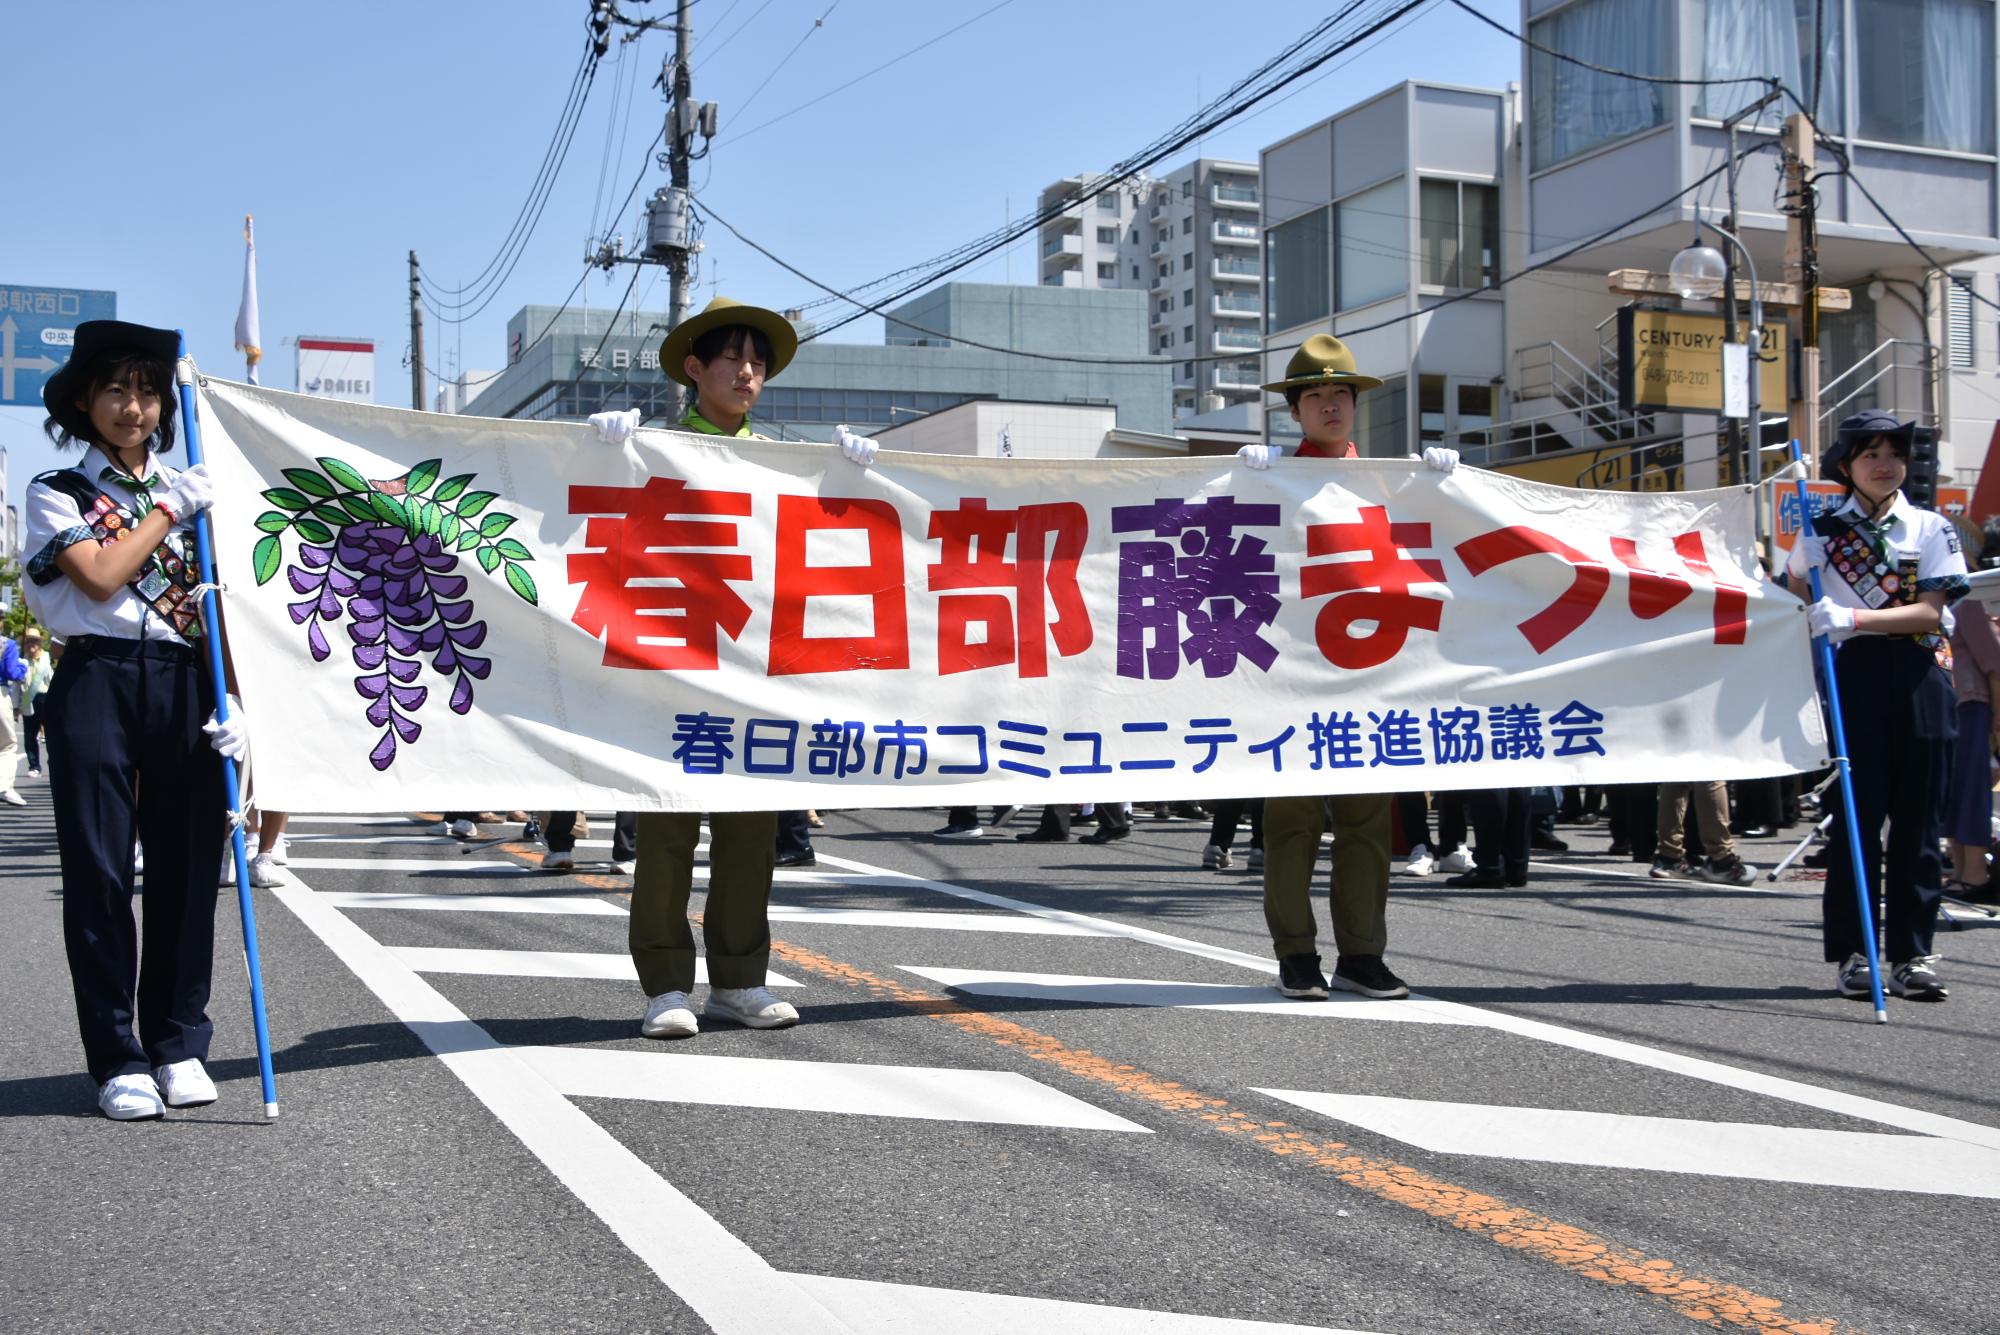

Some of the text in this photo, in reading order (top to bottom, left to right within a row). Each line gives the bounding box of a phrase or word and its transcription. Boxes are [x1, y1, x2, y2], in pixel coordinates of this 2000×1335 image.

[45, 331, 75, 343] 中央
[1639, 329, 1715, 349] CENTURY
[324, 378, 371, 394] DAIEI
[566, 476, 1748, 680] 春日部藤まつり
[671, 700, 1607, 779] 春日部市コミュニティ推進協議会
